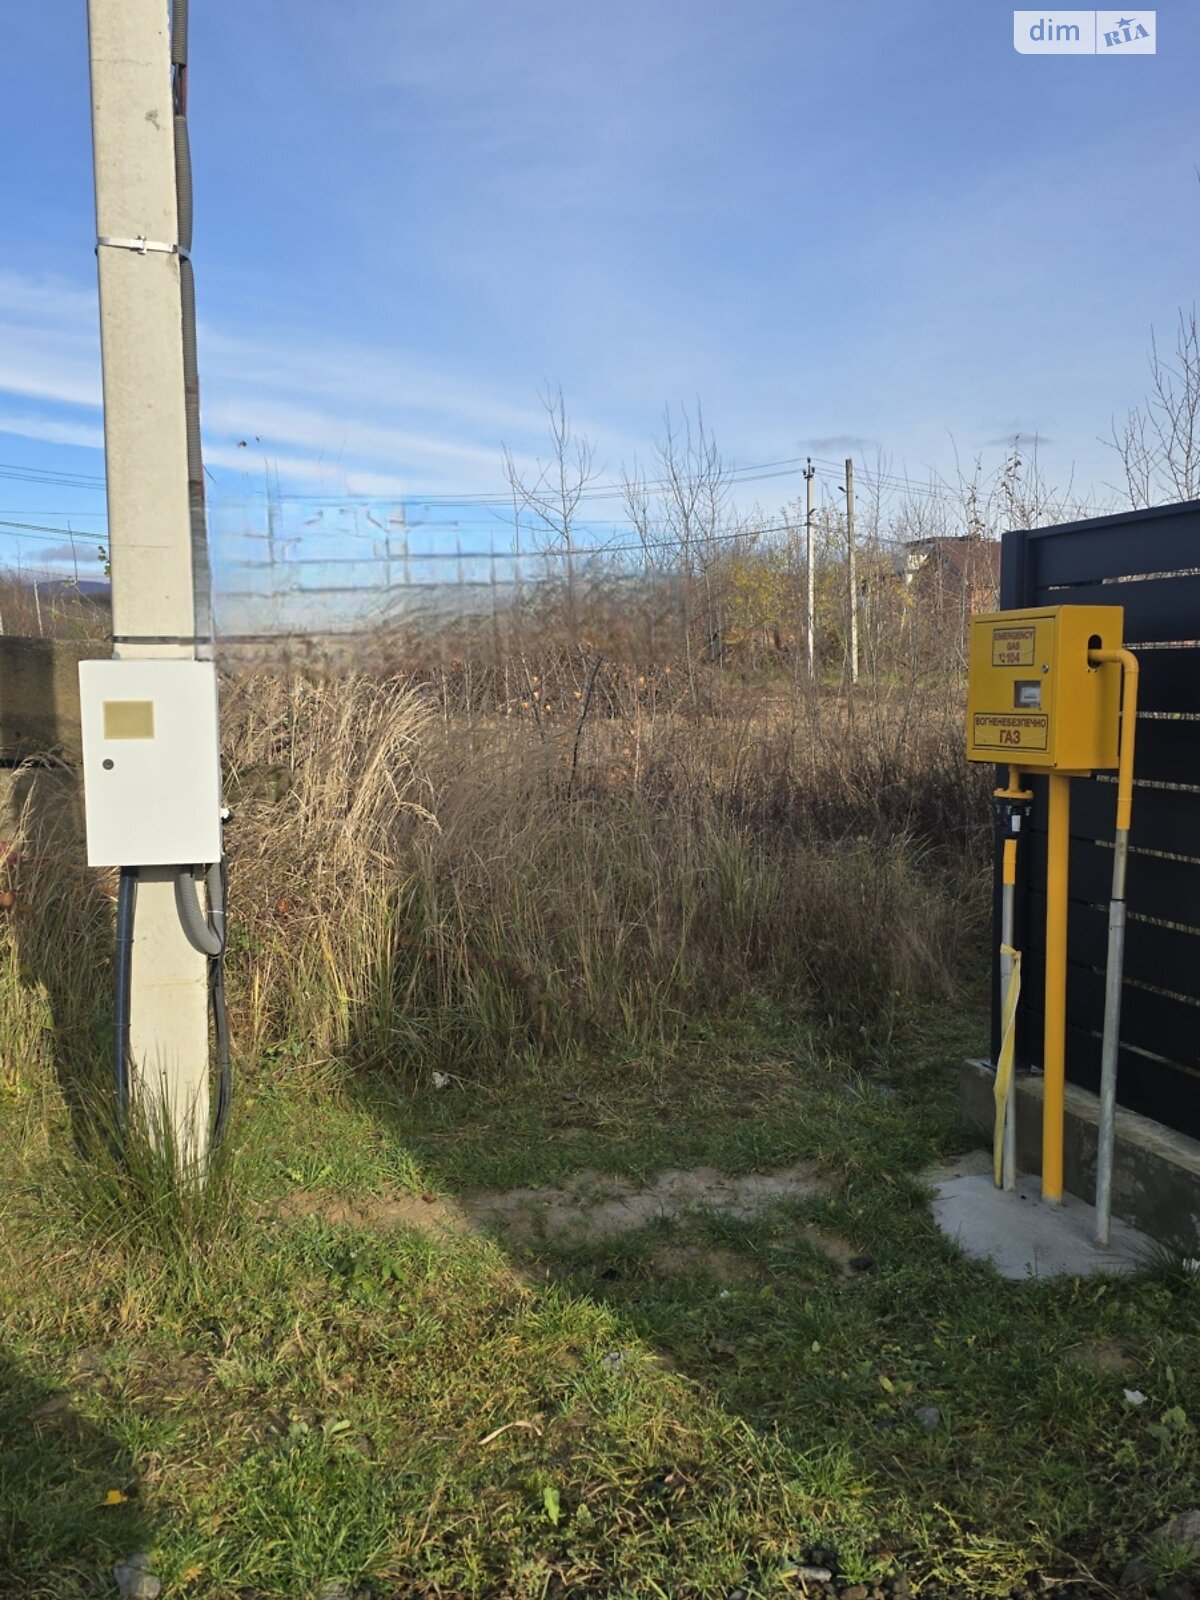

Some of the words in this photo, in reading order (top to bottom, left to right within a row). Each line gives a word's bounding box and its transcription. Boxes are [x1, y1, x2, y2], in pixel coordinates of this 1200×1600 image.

[994, 631, 1033, 640] EMERGENCY
[1007, 641, 1020, 651] GAS
[1007, 652, 1020, 663] 104
[975, 717, 1046, 728] ВОГНЕНЕБЕЗПЕЧНО
[999, 730, 1021, 744] ГАЗ
